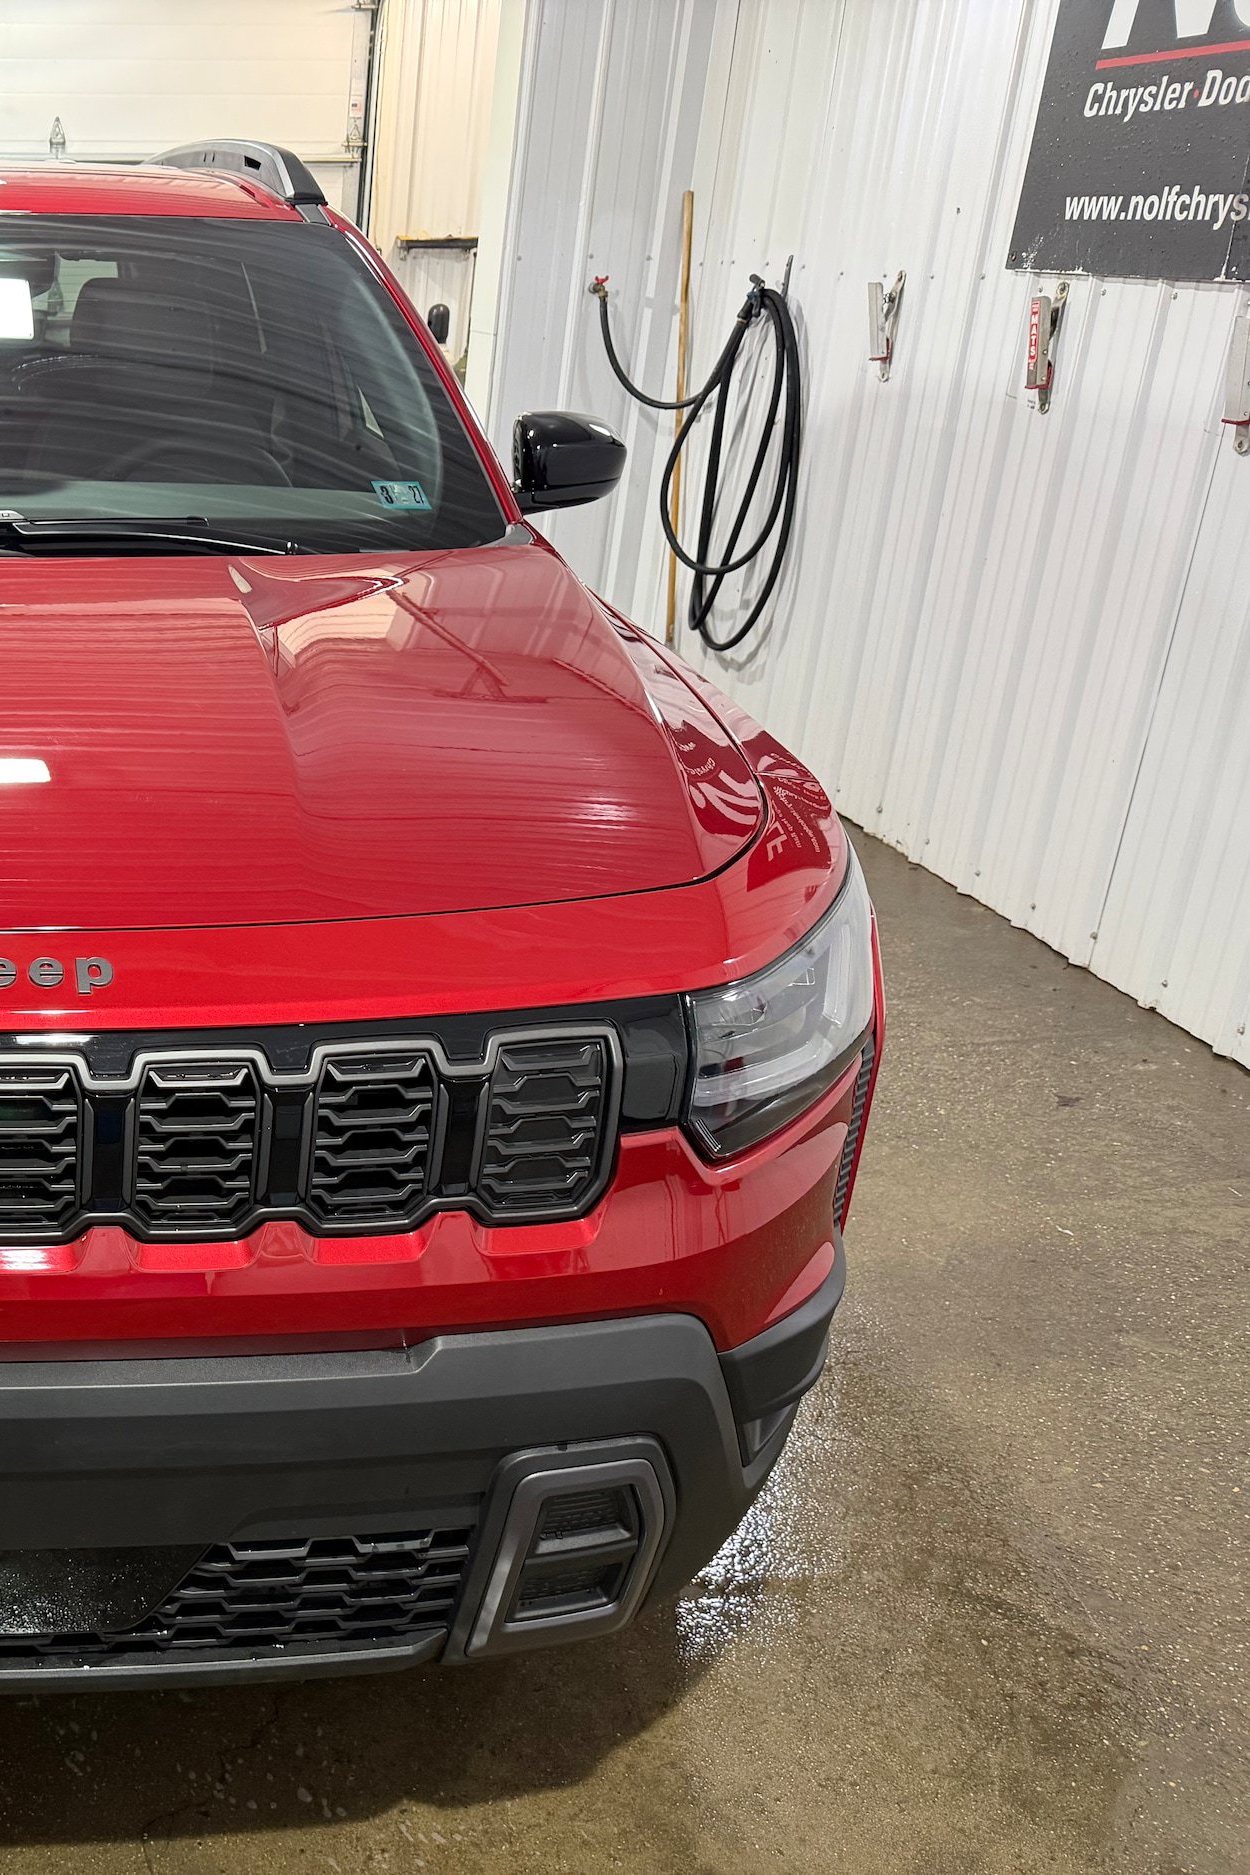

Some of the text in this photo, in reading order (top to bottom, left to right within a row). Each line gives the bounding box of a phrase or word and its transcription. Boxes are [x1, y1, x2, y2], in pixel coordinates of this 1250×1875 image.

[1083, 75, 1194, 122] Chrysler
[1063, 184, 1250, 231] www.nolfchrys
[1030, 314, 1039, 356] MATS
[380, 485, 394, 504] 3
